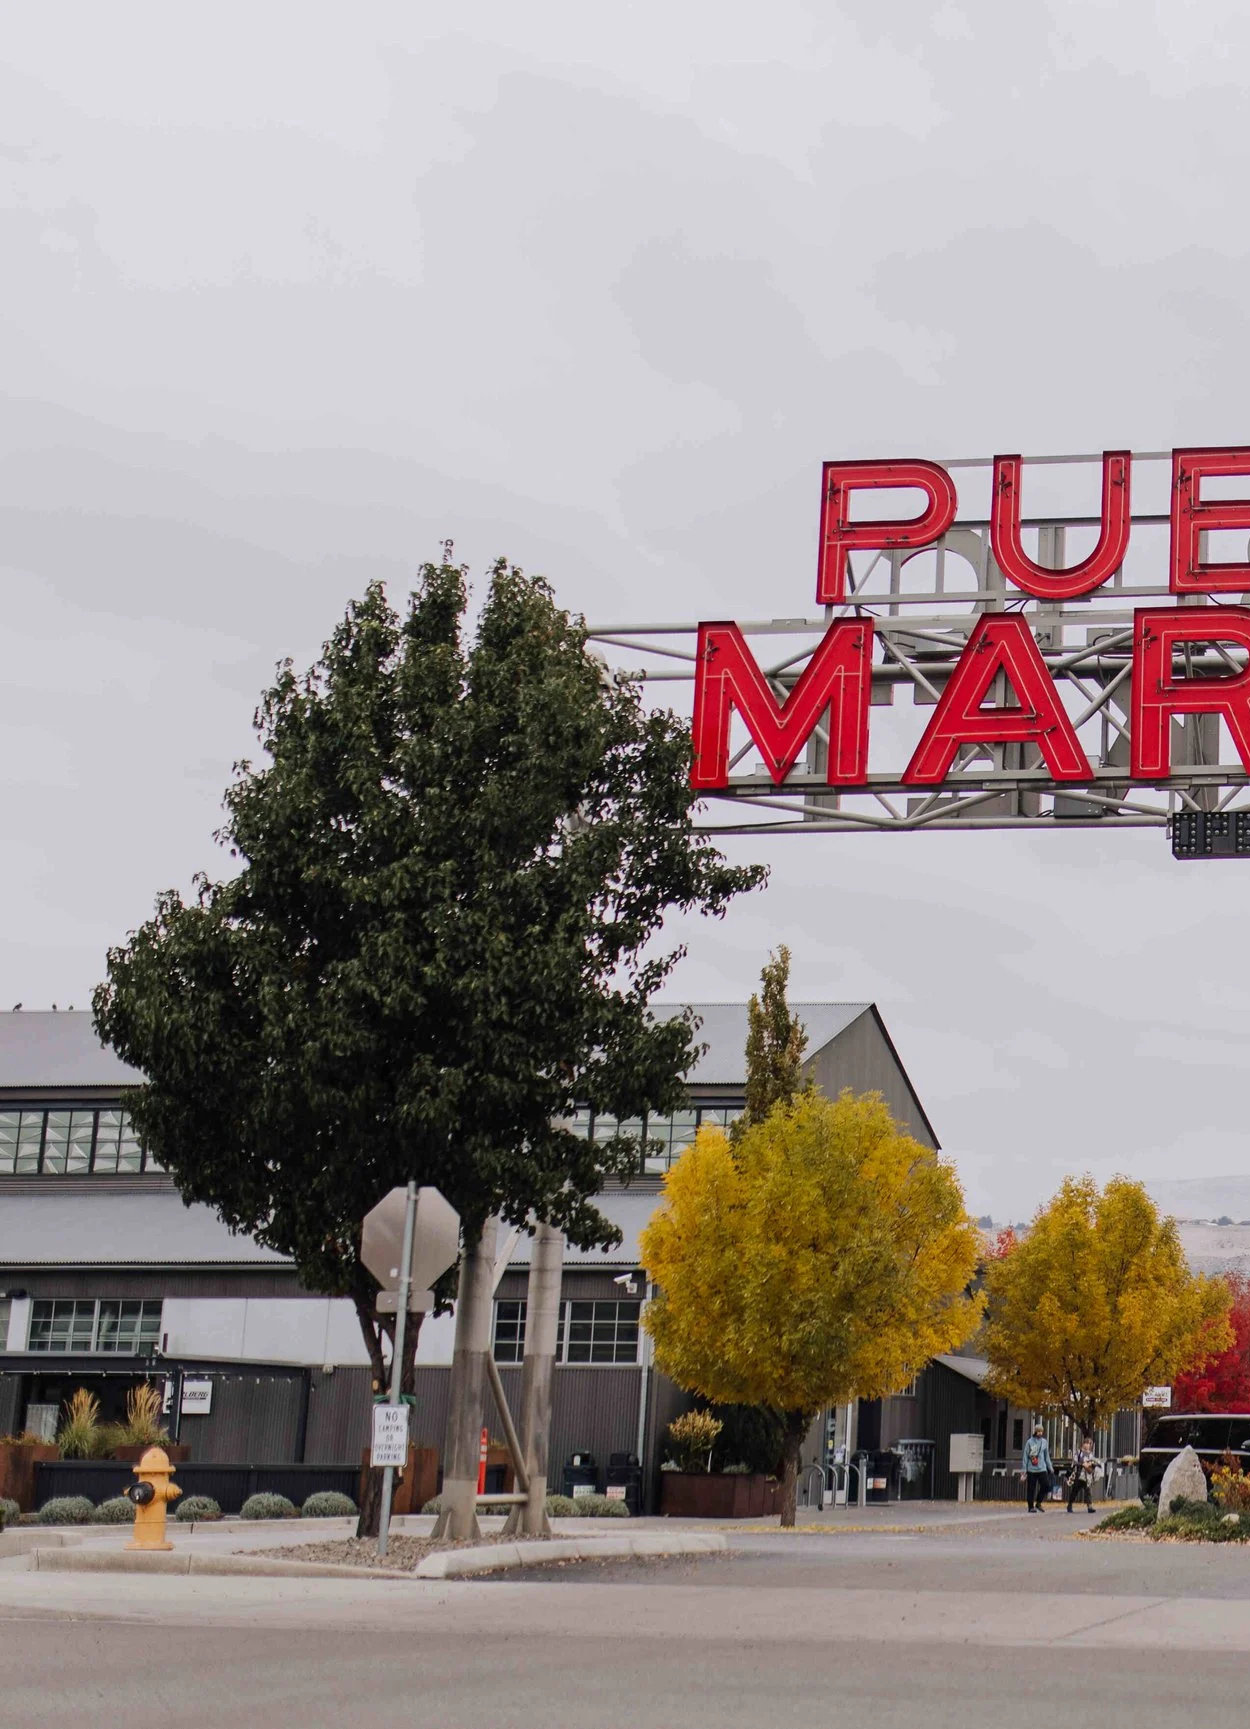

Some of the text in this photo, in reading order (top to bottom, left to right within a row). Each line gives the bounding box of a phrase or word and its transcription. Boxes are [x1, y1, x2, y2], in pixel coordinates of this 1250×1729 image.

[385, 1411, 398, 1422] NO
[378, 1424, 404, 1433] CAMPING
[386, 1434, 393, 1442] OR
[375, 1443, 405, 1452] OVERNIGHT
[376, 1453, 402, 1461] PARKING
